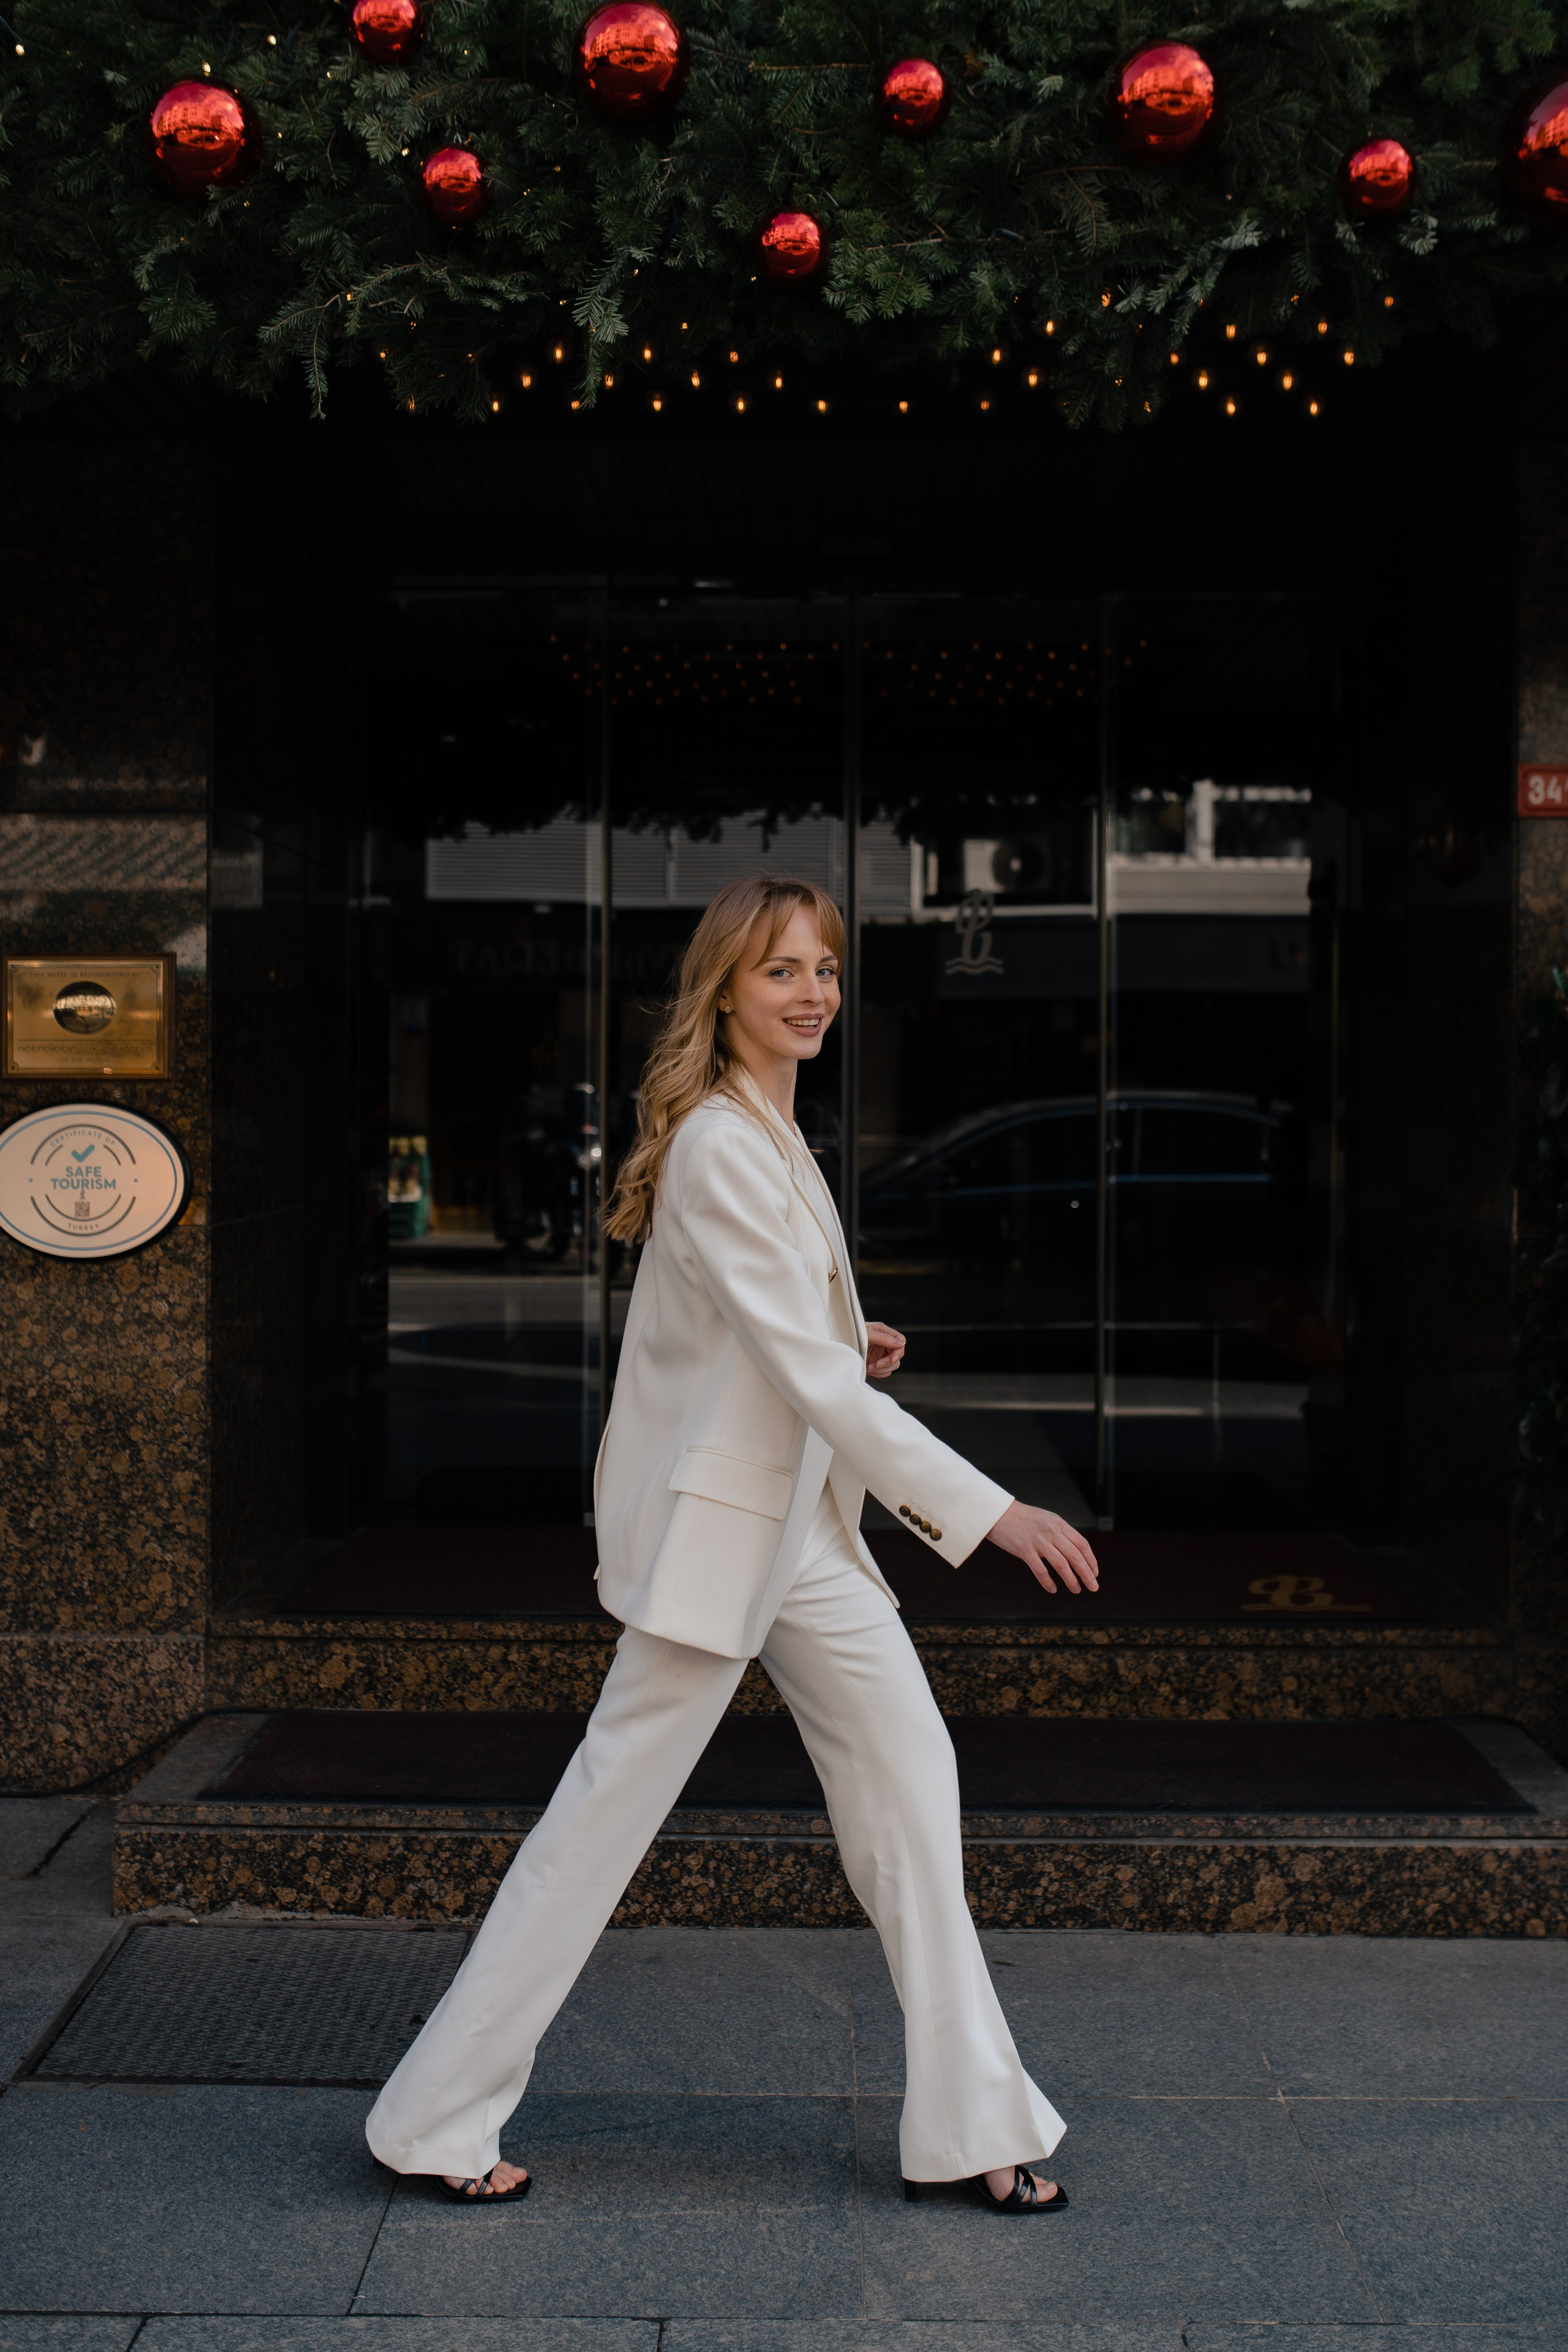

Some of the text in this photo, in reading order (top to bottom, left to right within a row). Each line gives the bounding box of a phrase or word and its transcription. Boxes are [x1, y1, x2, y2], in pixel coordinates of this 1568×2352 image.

[1528, 775, 1568, 805] 34
[17, 1044, 153, 1054] INDEPENDENT LUXURY HOTELS
[50, 1129, 102, 1147] CERTIFICATE
[66, 1166, 102, 1177] SAFE
[50, 1178, 116, 1190] TOURISM
[68, 1223, 99, 1231] TURKEY
